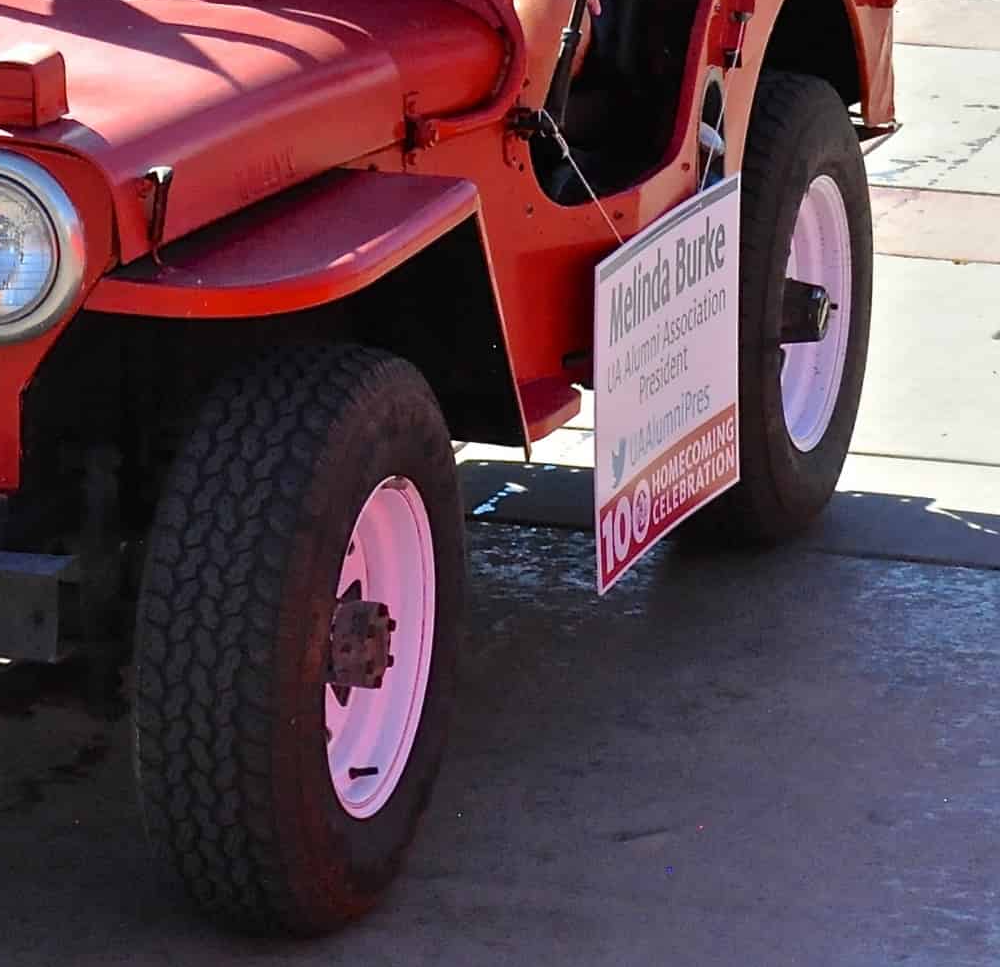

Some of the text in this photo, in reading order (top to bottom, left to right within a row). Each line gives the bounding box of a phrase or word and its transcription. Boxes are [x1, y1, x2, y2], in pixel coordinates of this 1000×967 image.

[608, 215, 726, 347] Melinda Burke
[606, 288, 726, 394] UA Alumni Association
[639, 348, 689, 404] President
[630, 384, 711, 466] UAAlumniPres
[651, 417, 735, 498] HOMECOMING
[652, 445, 735, 524] CELEBRATION
[601, 479, 650, 574] 100
